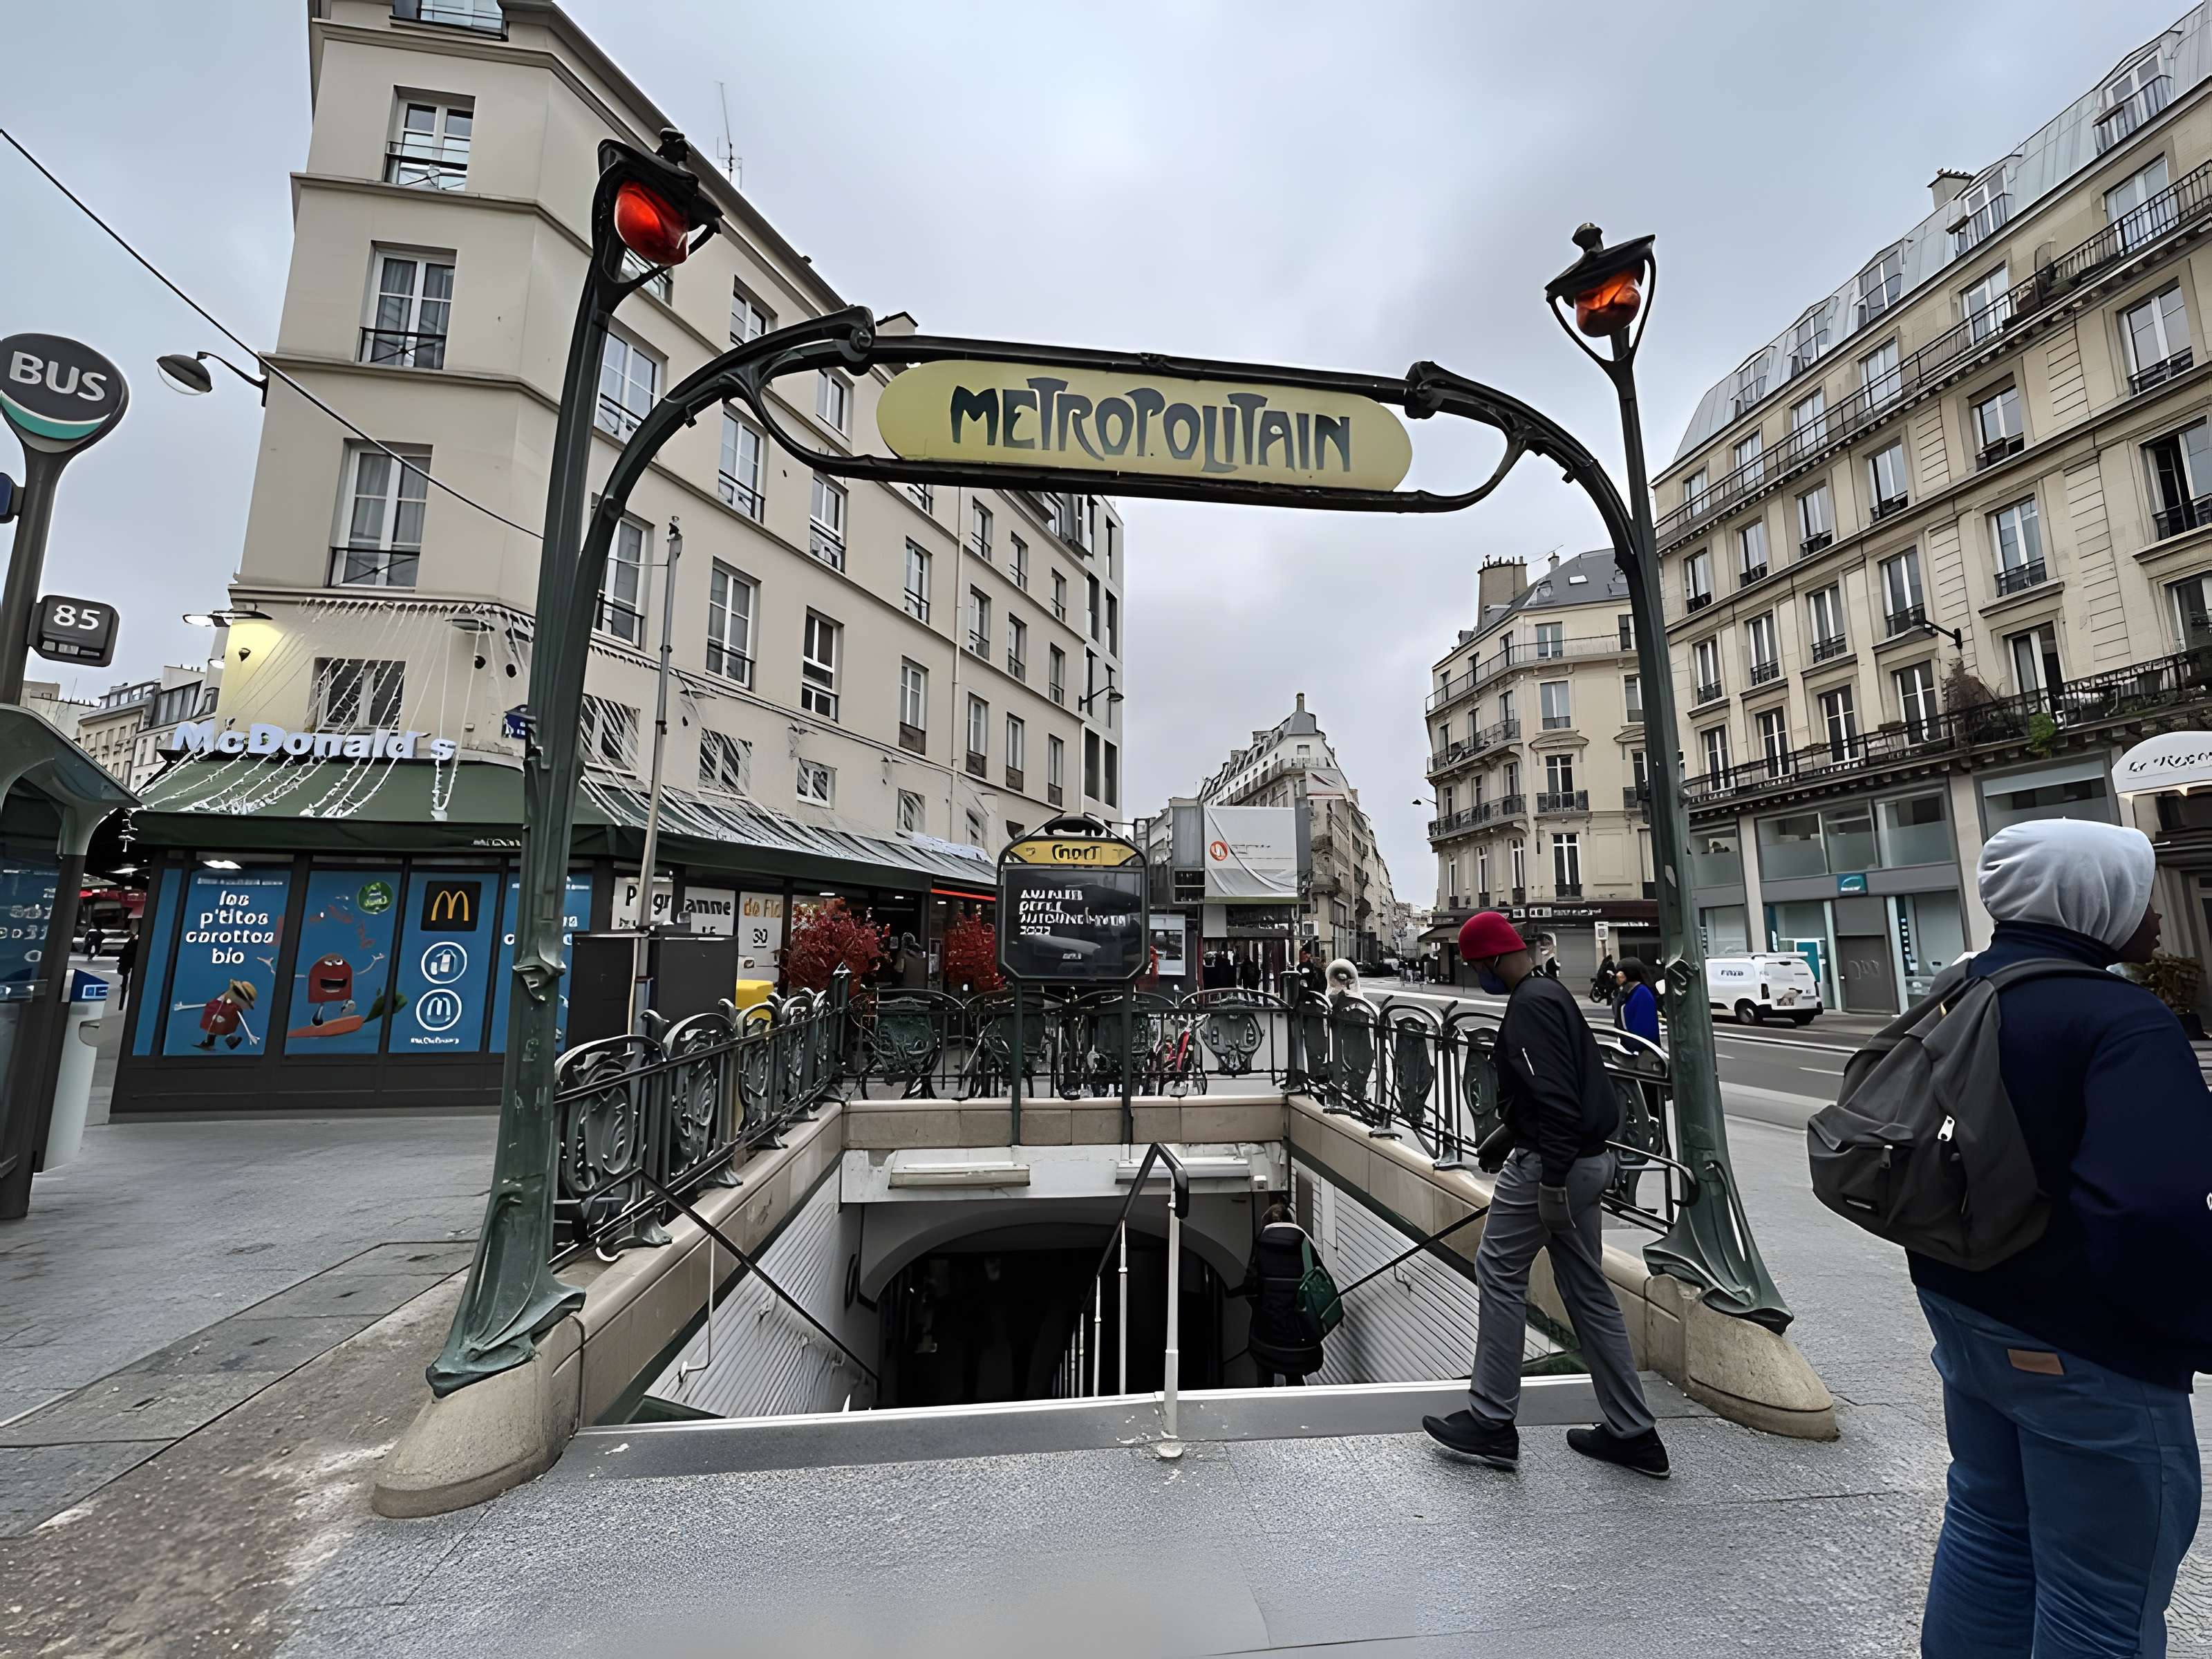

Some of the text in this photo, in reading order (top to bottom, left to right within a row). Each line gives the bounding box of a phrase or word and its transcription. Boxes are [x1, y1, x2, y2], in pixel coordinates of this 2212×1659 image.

[10, 350, 107, 402] BUS
[950, 377, 1351, 474] METROPOLITAIN
[53, 604, 101, 630] 85
